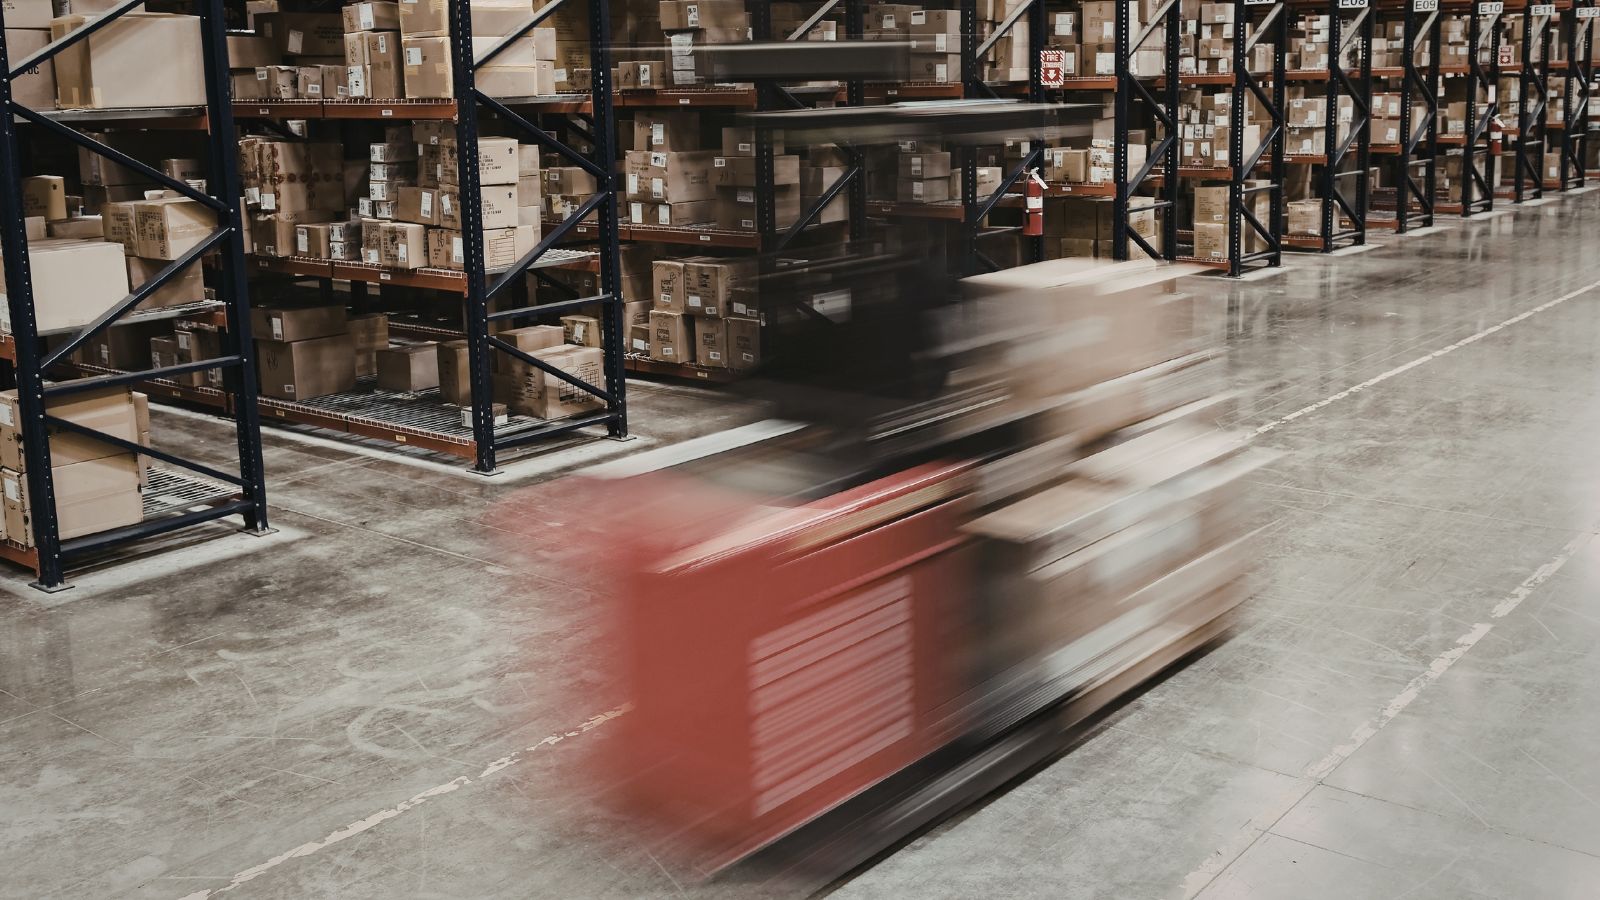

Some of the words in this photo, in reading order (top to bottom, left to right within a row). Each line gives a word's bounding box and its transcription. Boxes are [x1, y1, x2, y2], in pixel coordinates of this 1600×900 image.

[1415, 0, 1436, 9] E09
[1480, 4, 1501, 12] E10
[1534, 6, 1552, 14] E11
[1578, 8, 1598, 16] E12
